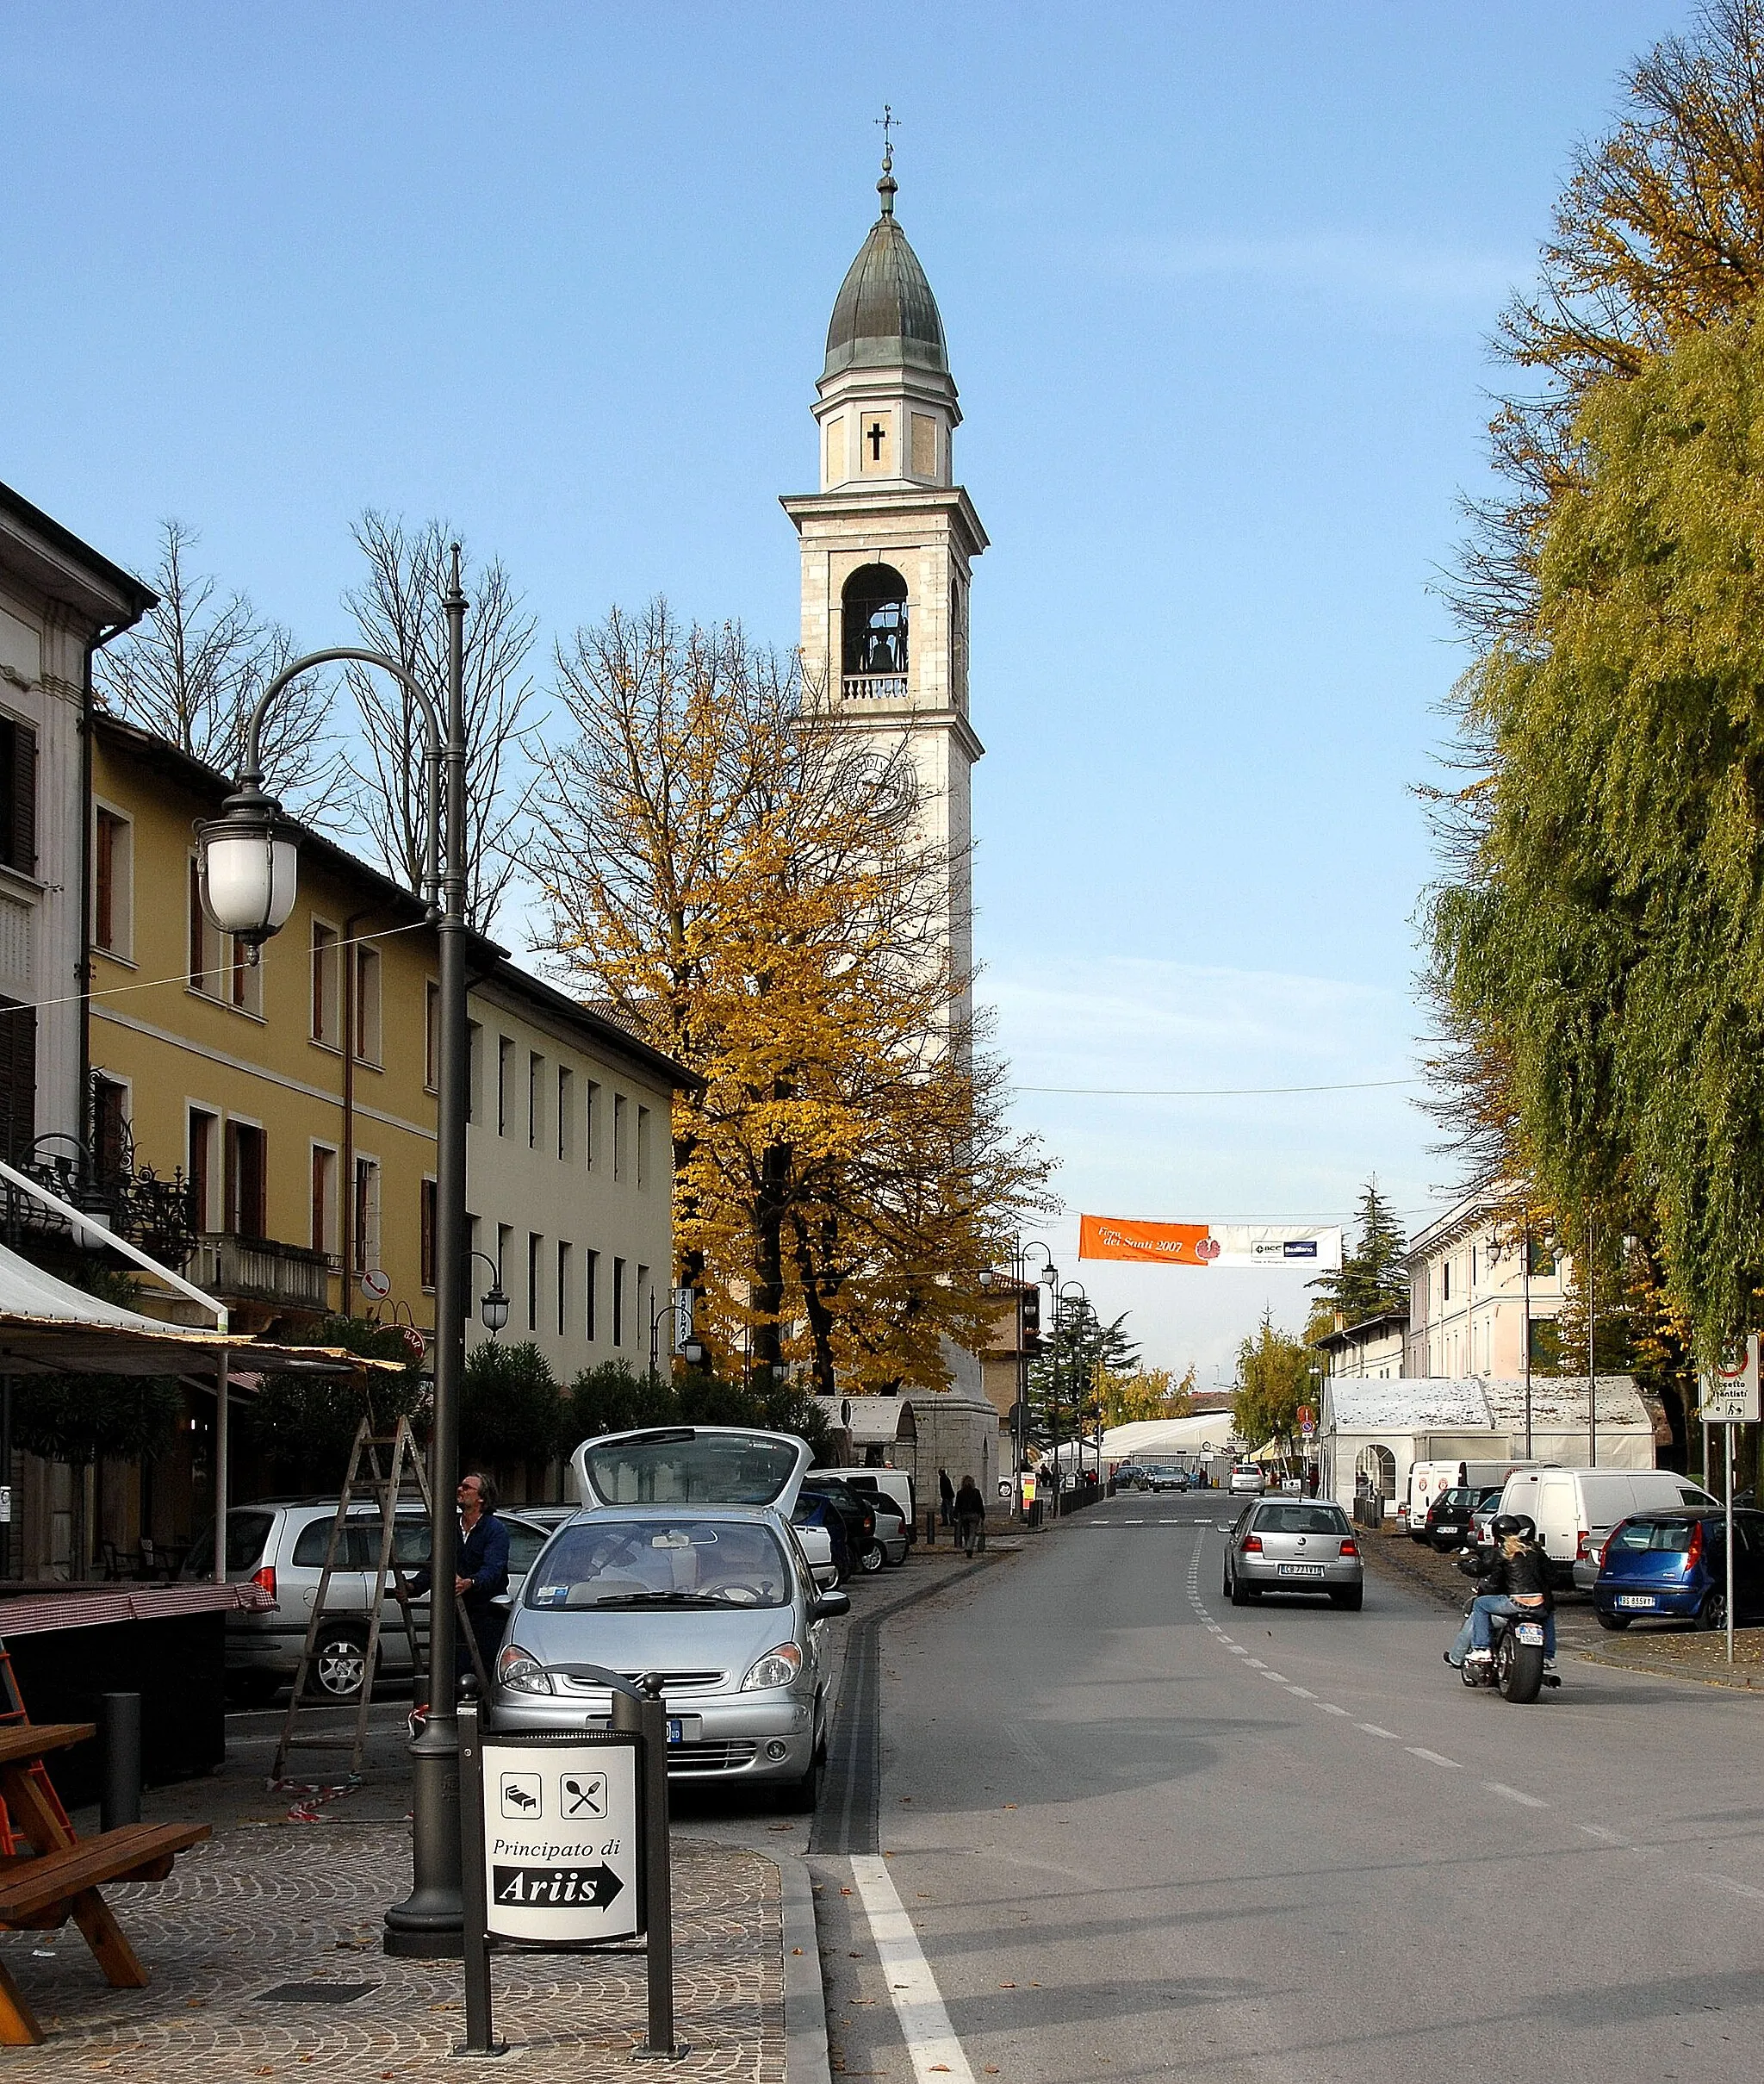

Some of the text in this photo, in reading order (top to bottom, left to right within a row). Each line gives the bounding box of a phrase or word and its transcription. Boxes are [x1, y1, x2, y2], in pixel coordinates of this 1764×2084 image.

[1098, 1227, 1121, 1236] Fiera
[1103, 1234, 1183, 1253] dei Santi 2007
[404, 1330, 420, 1348] BAR
[494, 1839, 620, 1861] Principato di
[499, 1871, 598, 1901] Ariis
